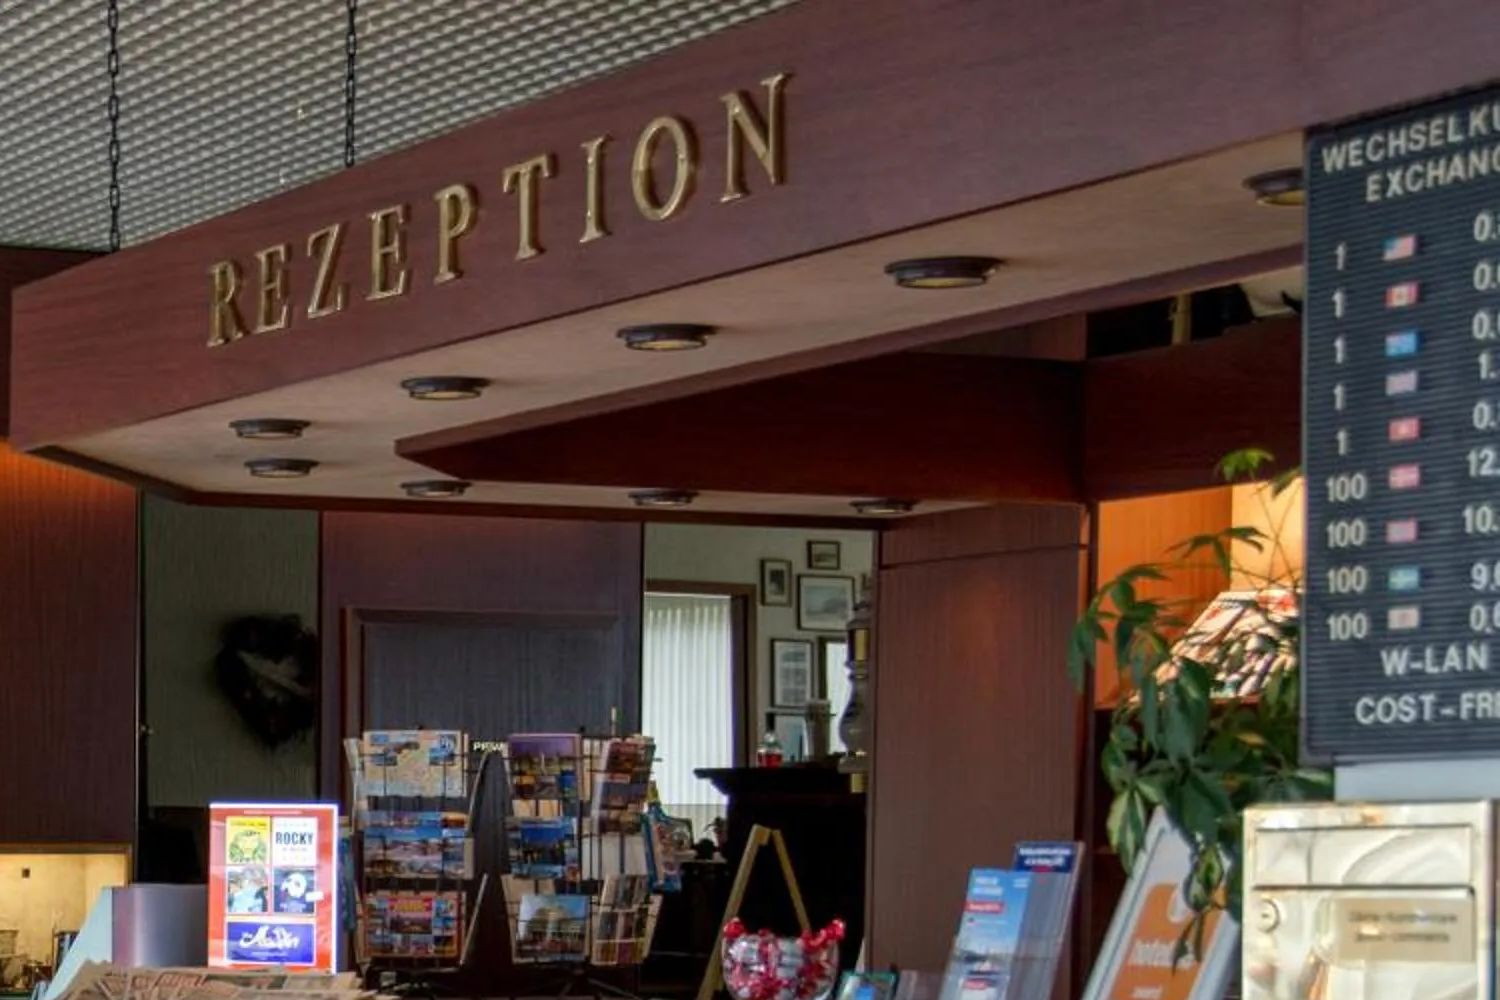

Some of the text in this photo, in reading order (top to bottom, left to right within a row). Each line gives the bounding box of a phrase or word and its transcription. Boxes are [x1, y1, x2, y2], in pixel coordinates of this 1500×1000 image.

[206, 72, 792, 348] REZEPTION
[1335, 212, 1500, 271] 1 0.
[1332, 261, 1500, 319] 1 0.
[1334, 311, 1500, 364] 1 0.
[1334, 383, 1344, 410] 1
[1336, 430, 1348, 456] 1
[1326, 473, 1367, 502] 100
[1326, 519, 1367, 548] 100
[1327, 566, 1368, 594] 100
[1327, 613, 1368, 641] 100
[1381, 643, 1488, 677] W-LAN
[275, 831, 314, 845] ROCKY
